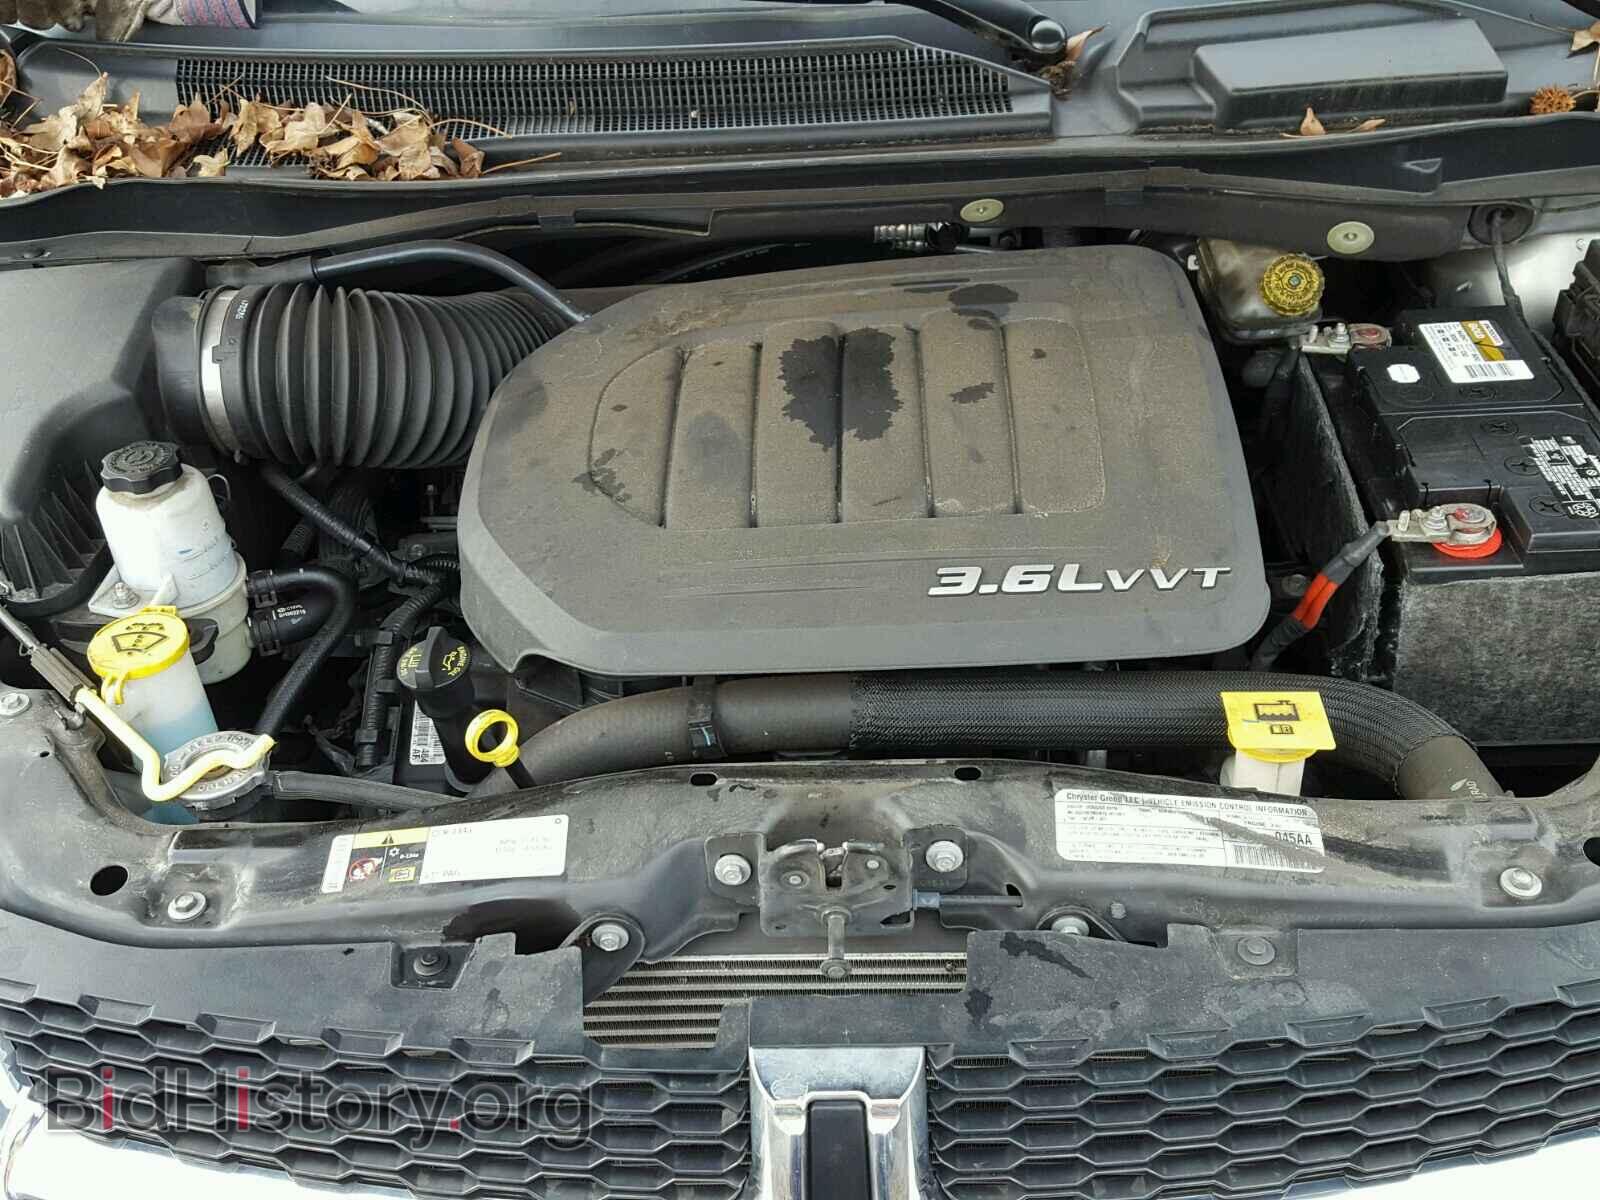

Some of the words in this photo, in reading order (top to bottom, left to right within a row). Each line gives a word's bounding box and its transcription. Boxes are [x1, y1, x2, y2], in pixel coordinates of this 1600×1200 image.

[1066, 792, 1098, 802] Chrysler
[1180, 799, 1217, 809] EMISSION
[1255, 805, 1308, 817] INFORMATION
